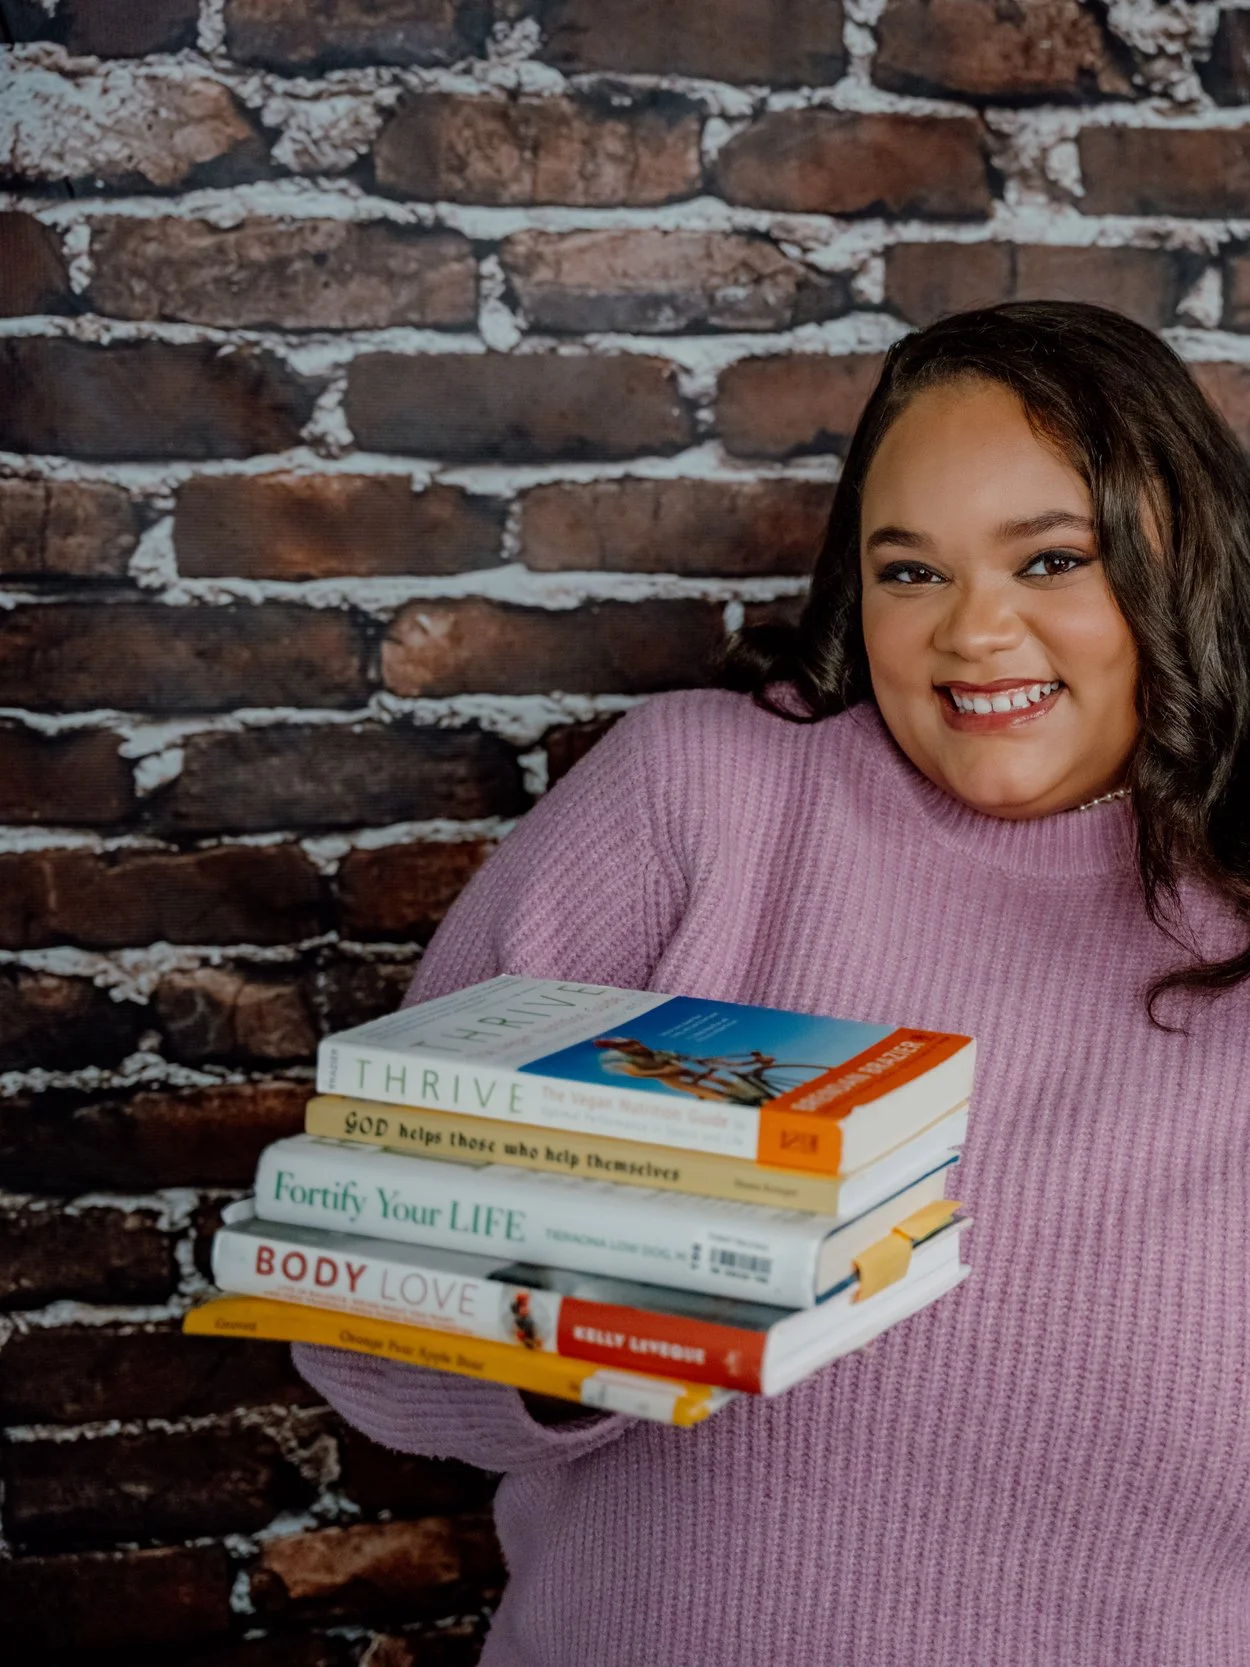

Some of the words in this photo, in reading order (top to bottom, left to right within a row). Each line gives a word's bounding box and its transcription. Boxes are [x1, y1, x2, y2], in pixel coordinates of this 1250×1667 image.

[409, 984, 607, 1052] THRIVE
[354, 1058, 525, 1115] THRIVE
[857, 1040, 926, 1075] BRAZIER
[344, 1111, 389, 1138] GOD
[397, 1122, 443, 1146] helps
[449, 1131, 496, 1153] those
[503, 1141, 539, 1161] who
[545, 1146, 581, 1170] help
[586, 1152, 682, 1183] themselves
[274, 1170, 367, 1222] Fortify
[376, 1187, 442, 1228] Your
[449, 1199, 526, 1243] LIFE
[255, 1245, 367, 1293] BODY
[380, 1268, 479, 1317] LOVE
[572, 1325, 626, 1348] KELLY
